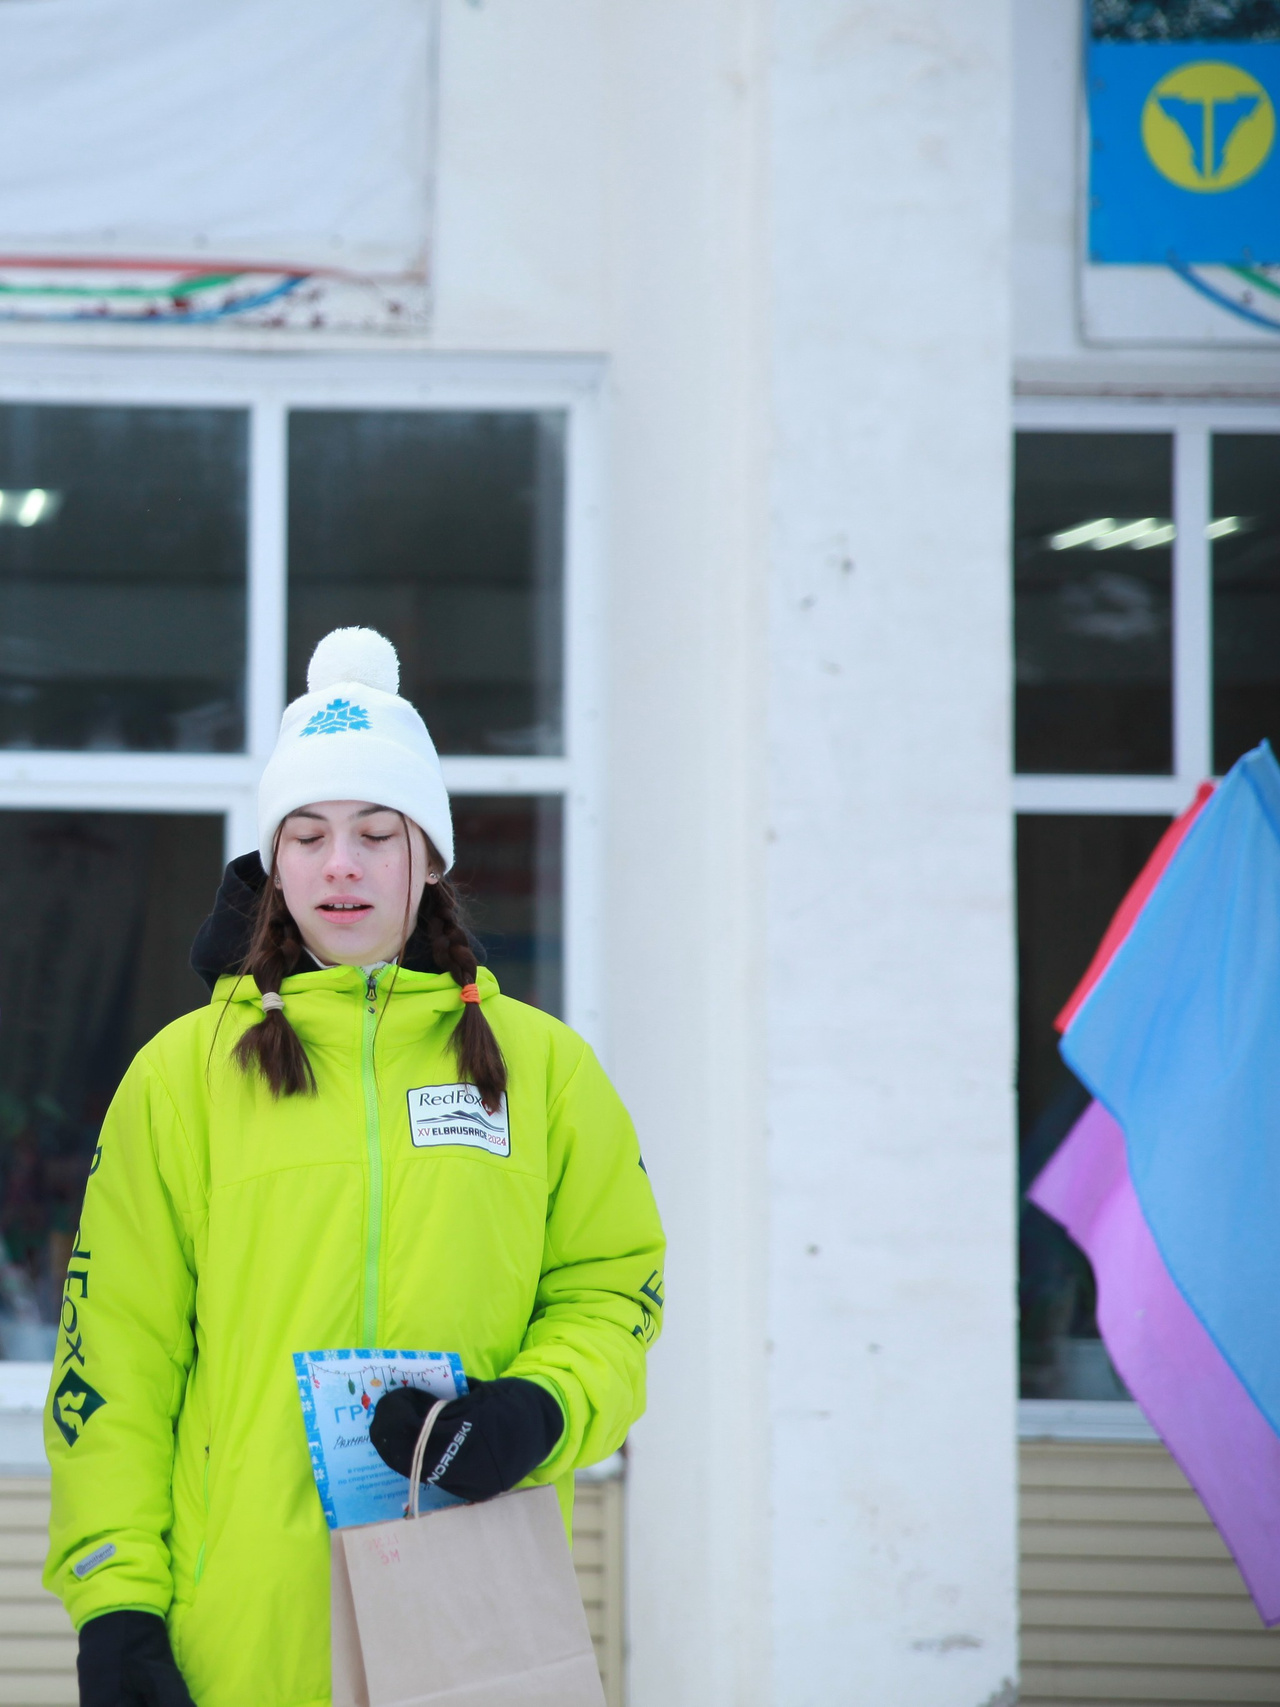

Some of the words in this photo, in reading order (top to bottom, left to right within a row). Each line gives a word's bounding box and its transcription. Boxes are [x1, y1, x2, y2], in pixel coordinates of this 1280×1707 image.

[418, 1128, 430, 1137] XV
[487, 1133, 507, 1147] 2024
[427, 1421, 473, 1485] NORDSKI
